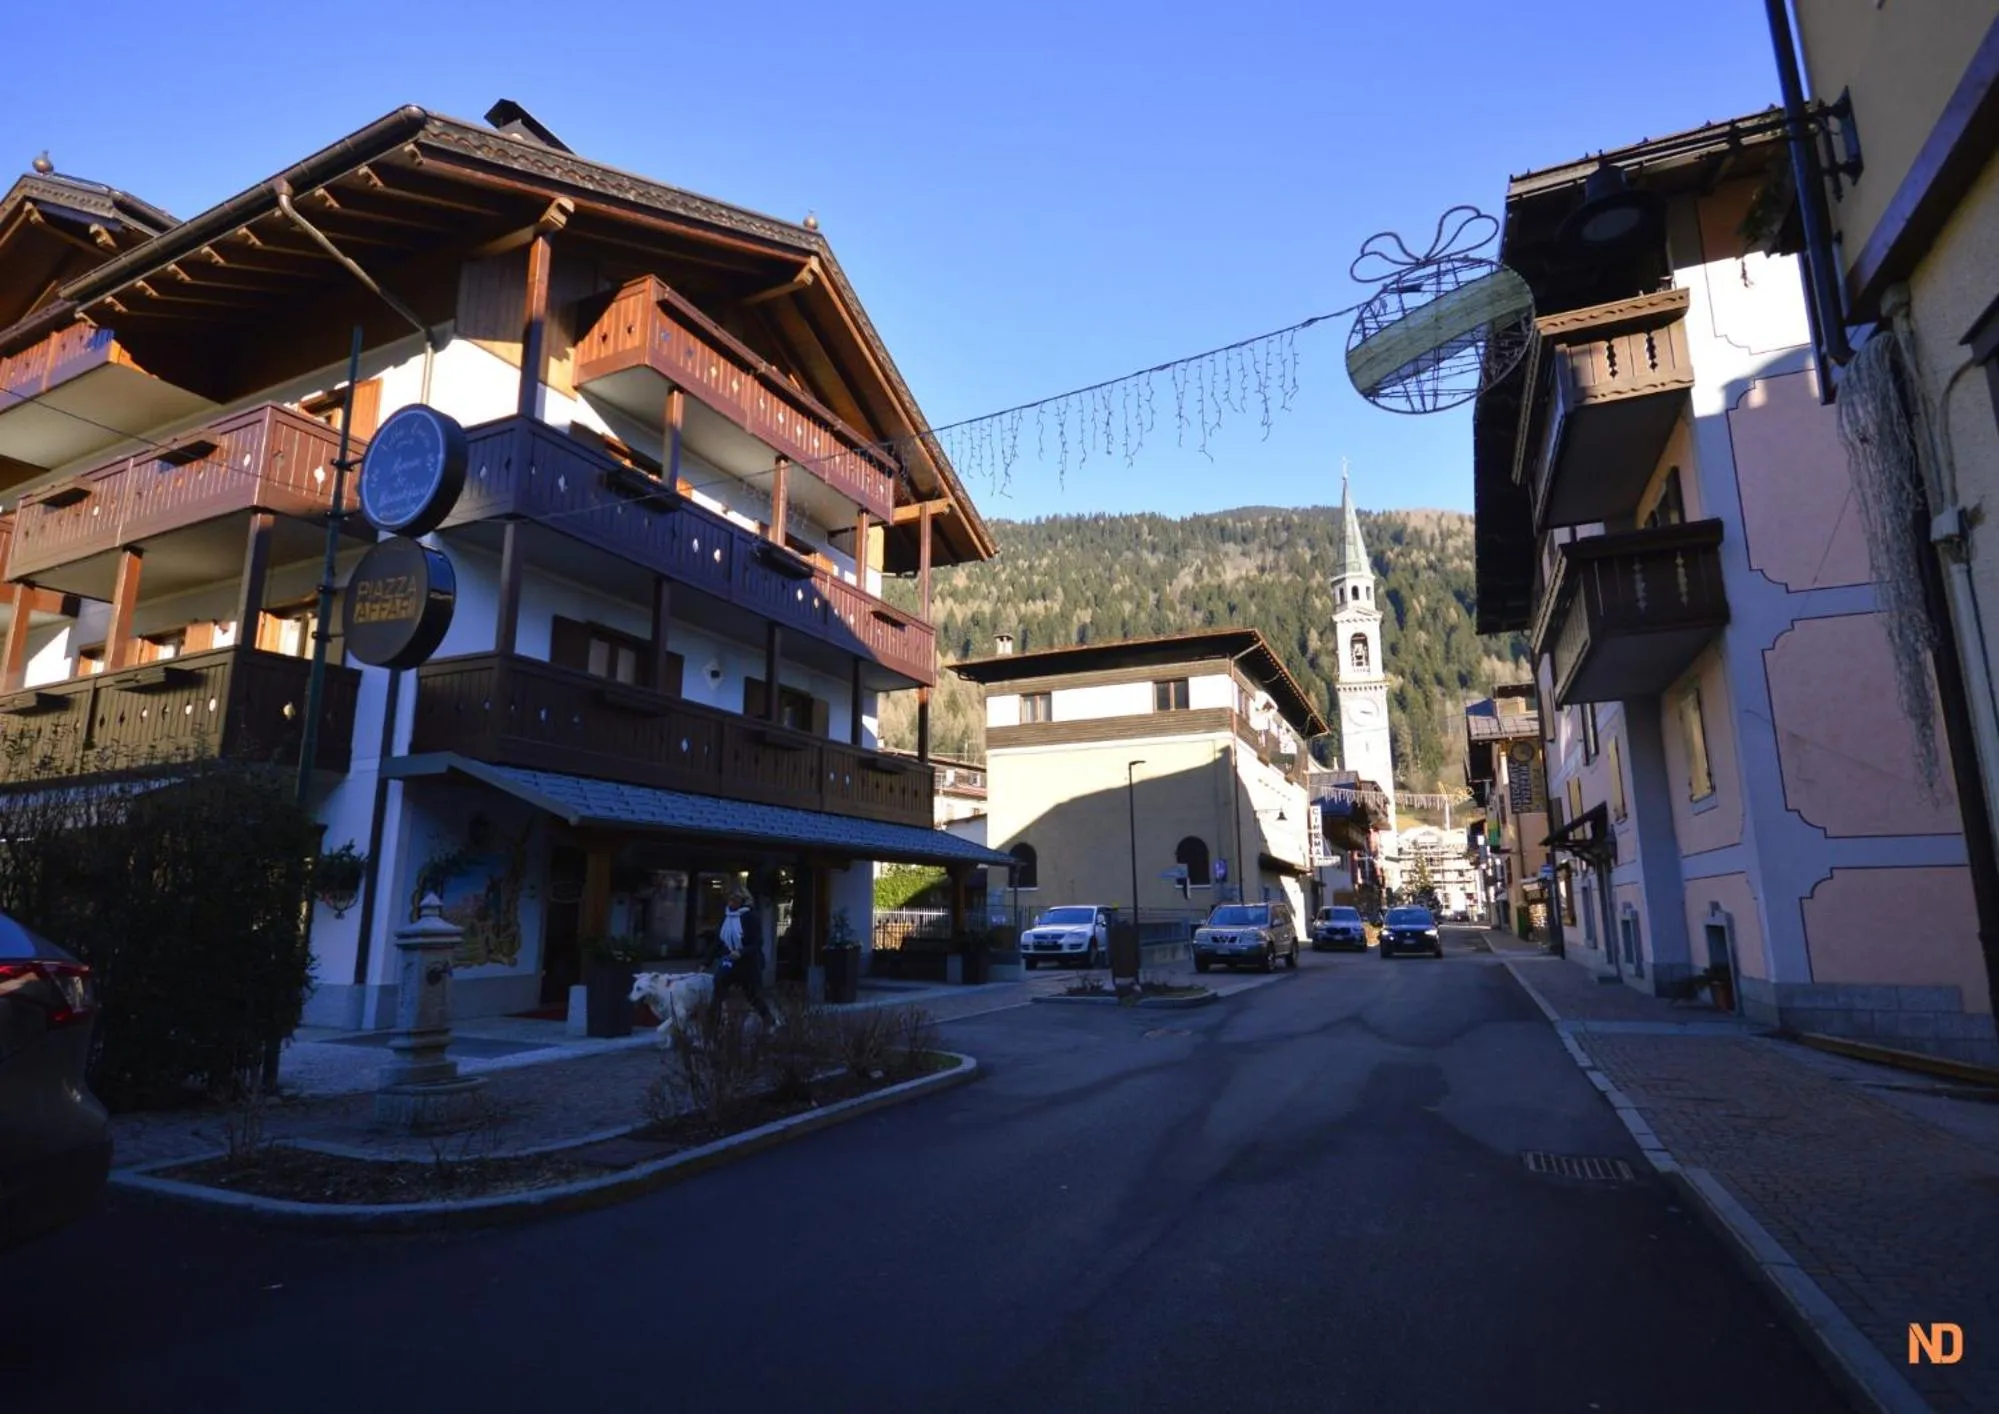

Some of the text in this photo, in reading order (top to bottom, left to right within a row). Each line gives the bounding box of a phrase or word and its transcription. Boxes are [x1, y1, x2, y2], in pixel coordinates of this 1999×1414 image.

[356, 575, 417, 601] PIAZZA
[353, 596, 418, 624] AFFARI
[1312, 807, 1321, 855] CINEMA
